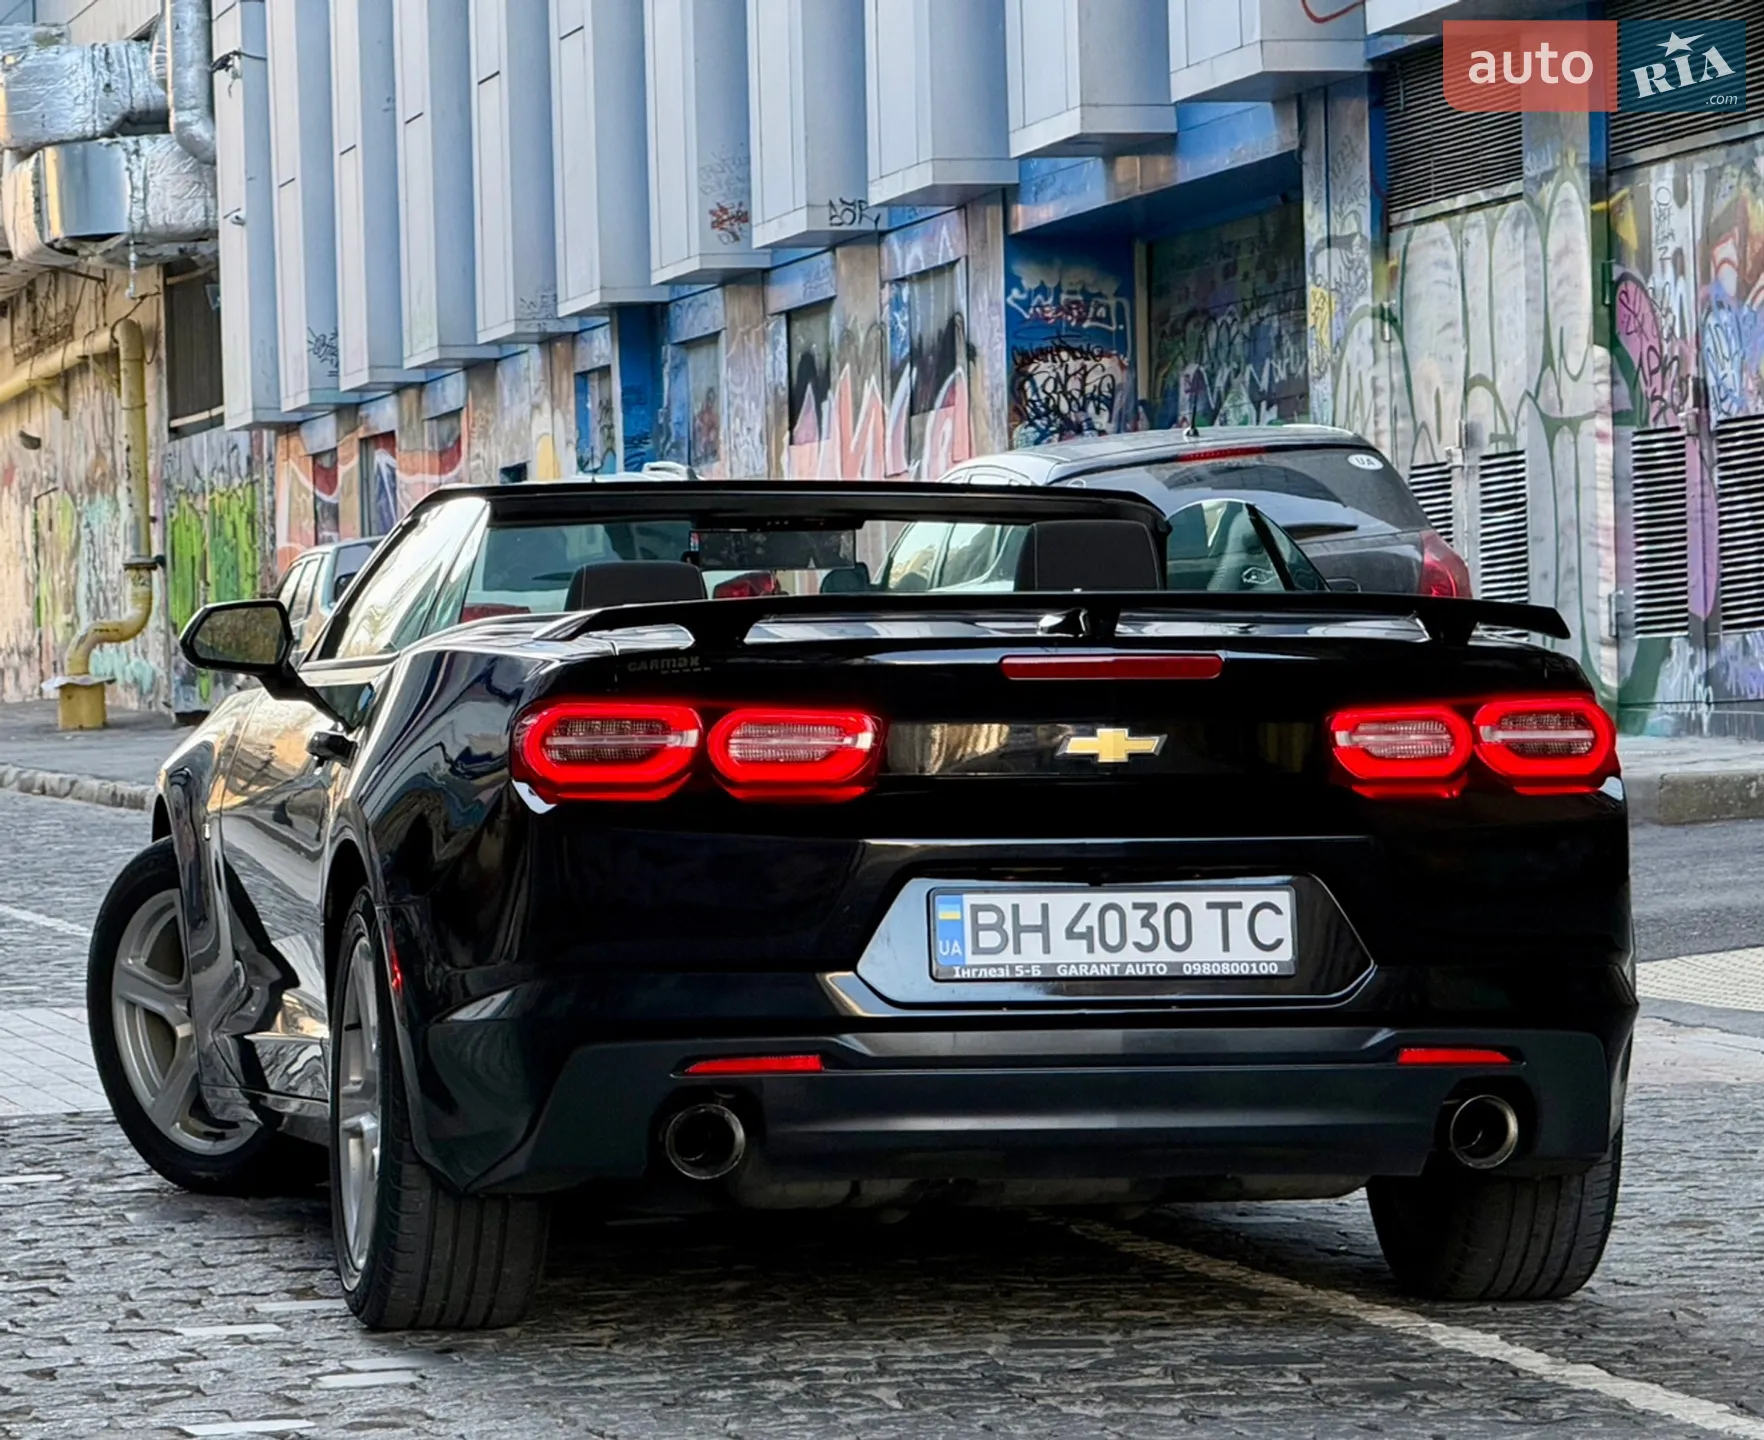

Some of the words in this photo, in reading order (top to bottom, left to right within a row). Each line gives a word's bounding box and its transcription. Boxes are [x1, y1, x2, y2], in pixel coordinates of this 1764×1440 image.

[1354, 456, 1377, 468] UA
[969, 902, 1051, 955] BH
[1064, 902, 1193, 954] 4030
[1206, 901, 1285, 953] TC
[938, 939, 963, 956] UA
[953, 965, 1010, 978] Інглезі
[1014, 964, 1042, 977] 5-Б
[1056, 963, 1121, 976] GARANT
[1125, 963, 1168, 976] AUTO
[1182, 962, 1279, 975] 0980800100
